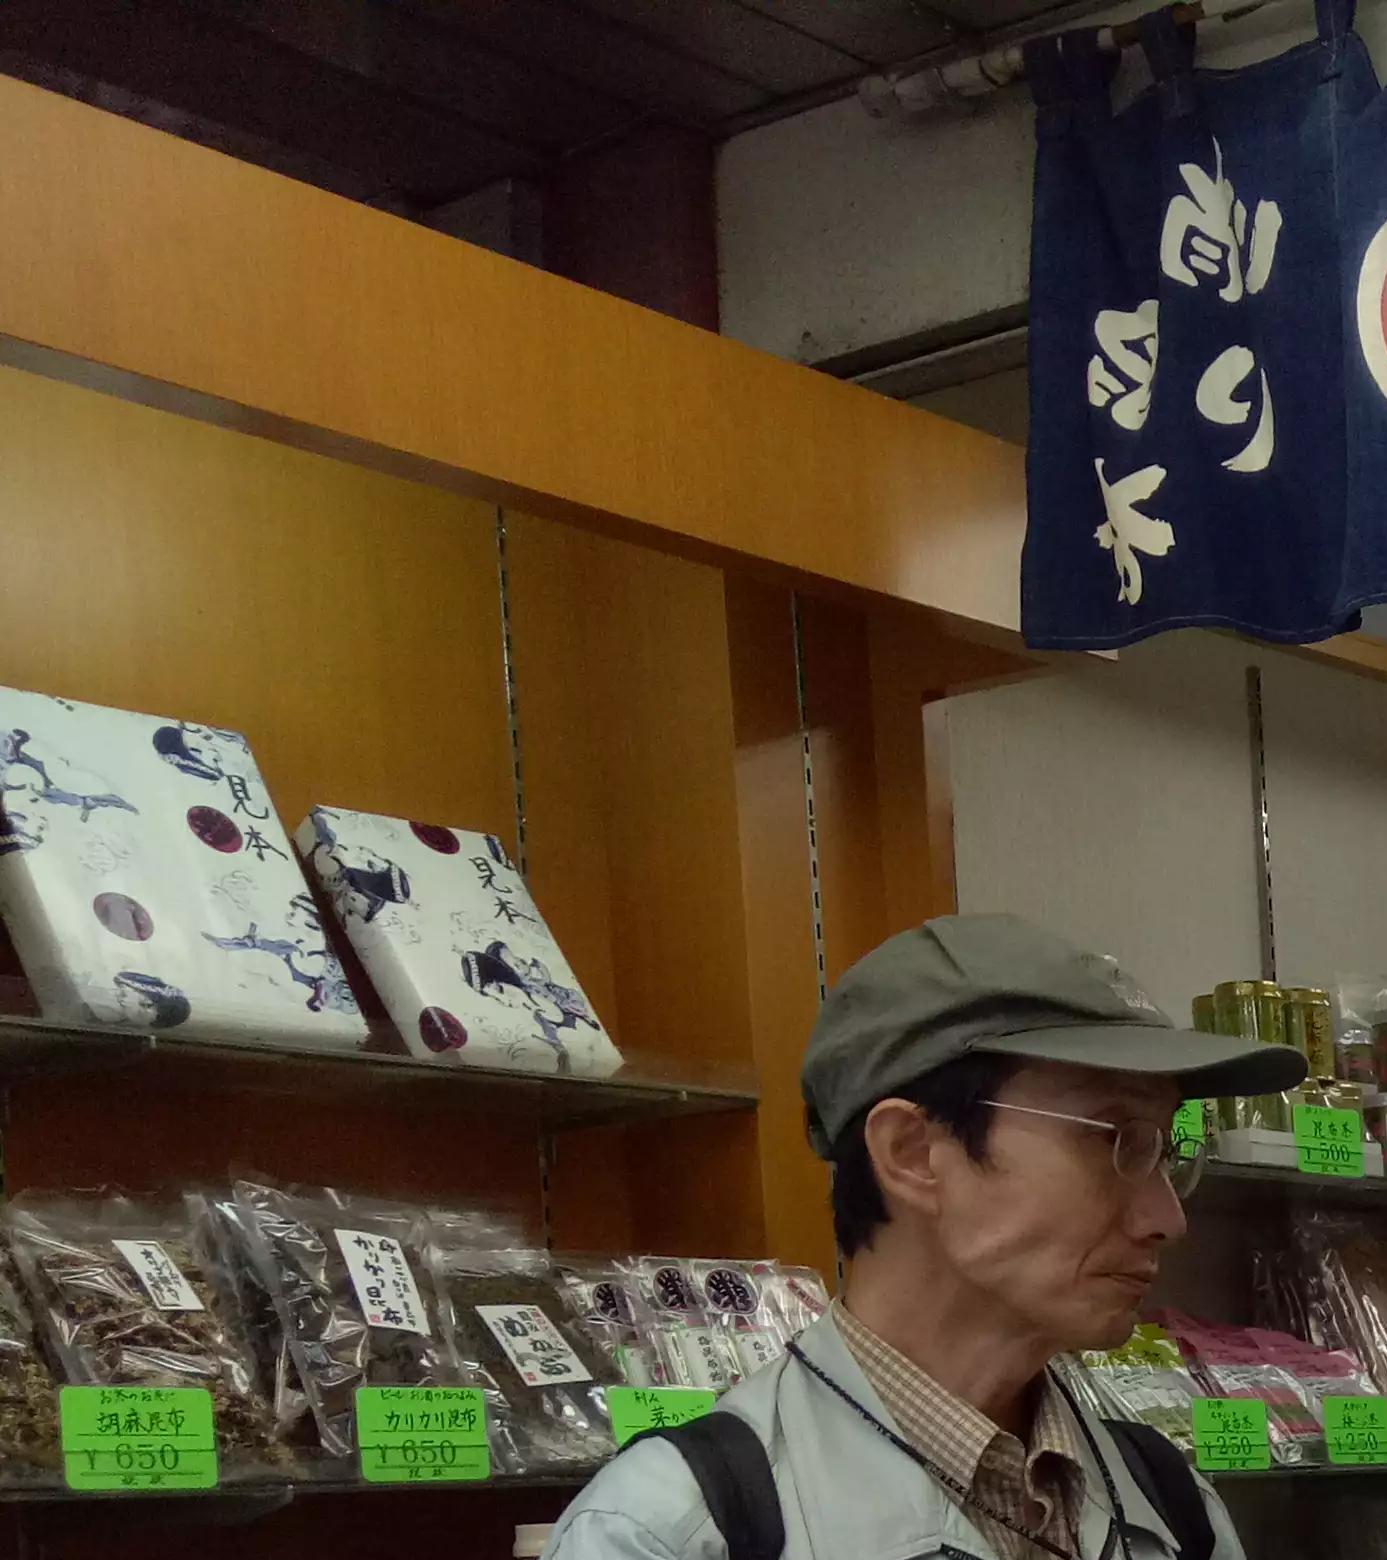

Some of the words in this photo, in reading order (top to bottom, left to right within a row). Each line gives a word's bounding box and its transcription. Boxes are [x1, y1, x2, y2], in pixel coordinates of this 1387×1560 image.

[226, 774, 289, 862] 見本
[468, 856, 537, 924] 見本
[96, 1407, 186, 1436] 胡麻昆布
[385, 1408, 477, 1433] カリカリ昆布
